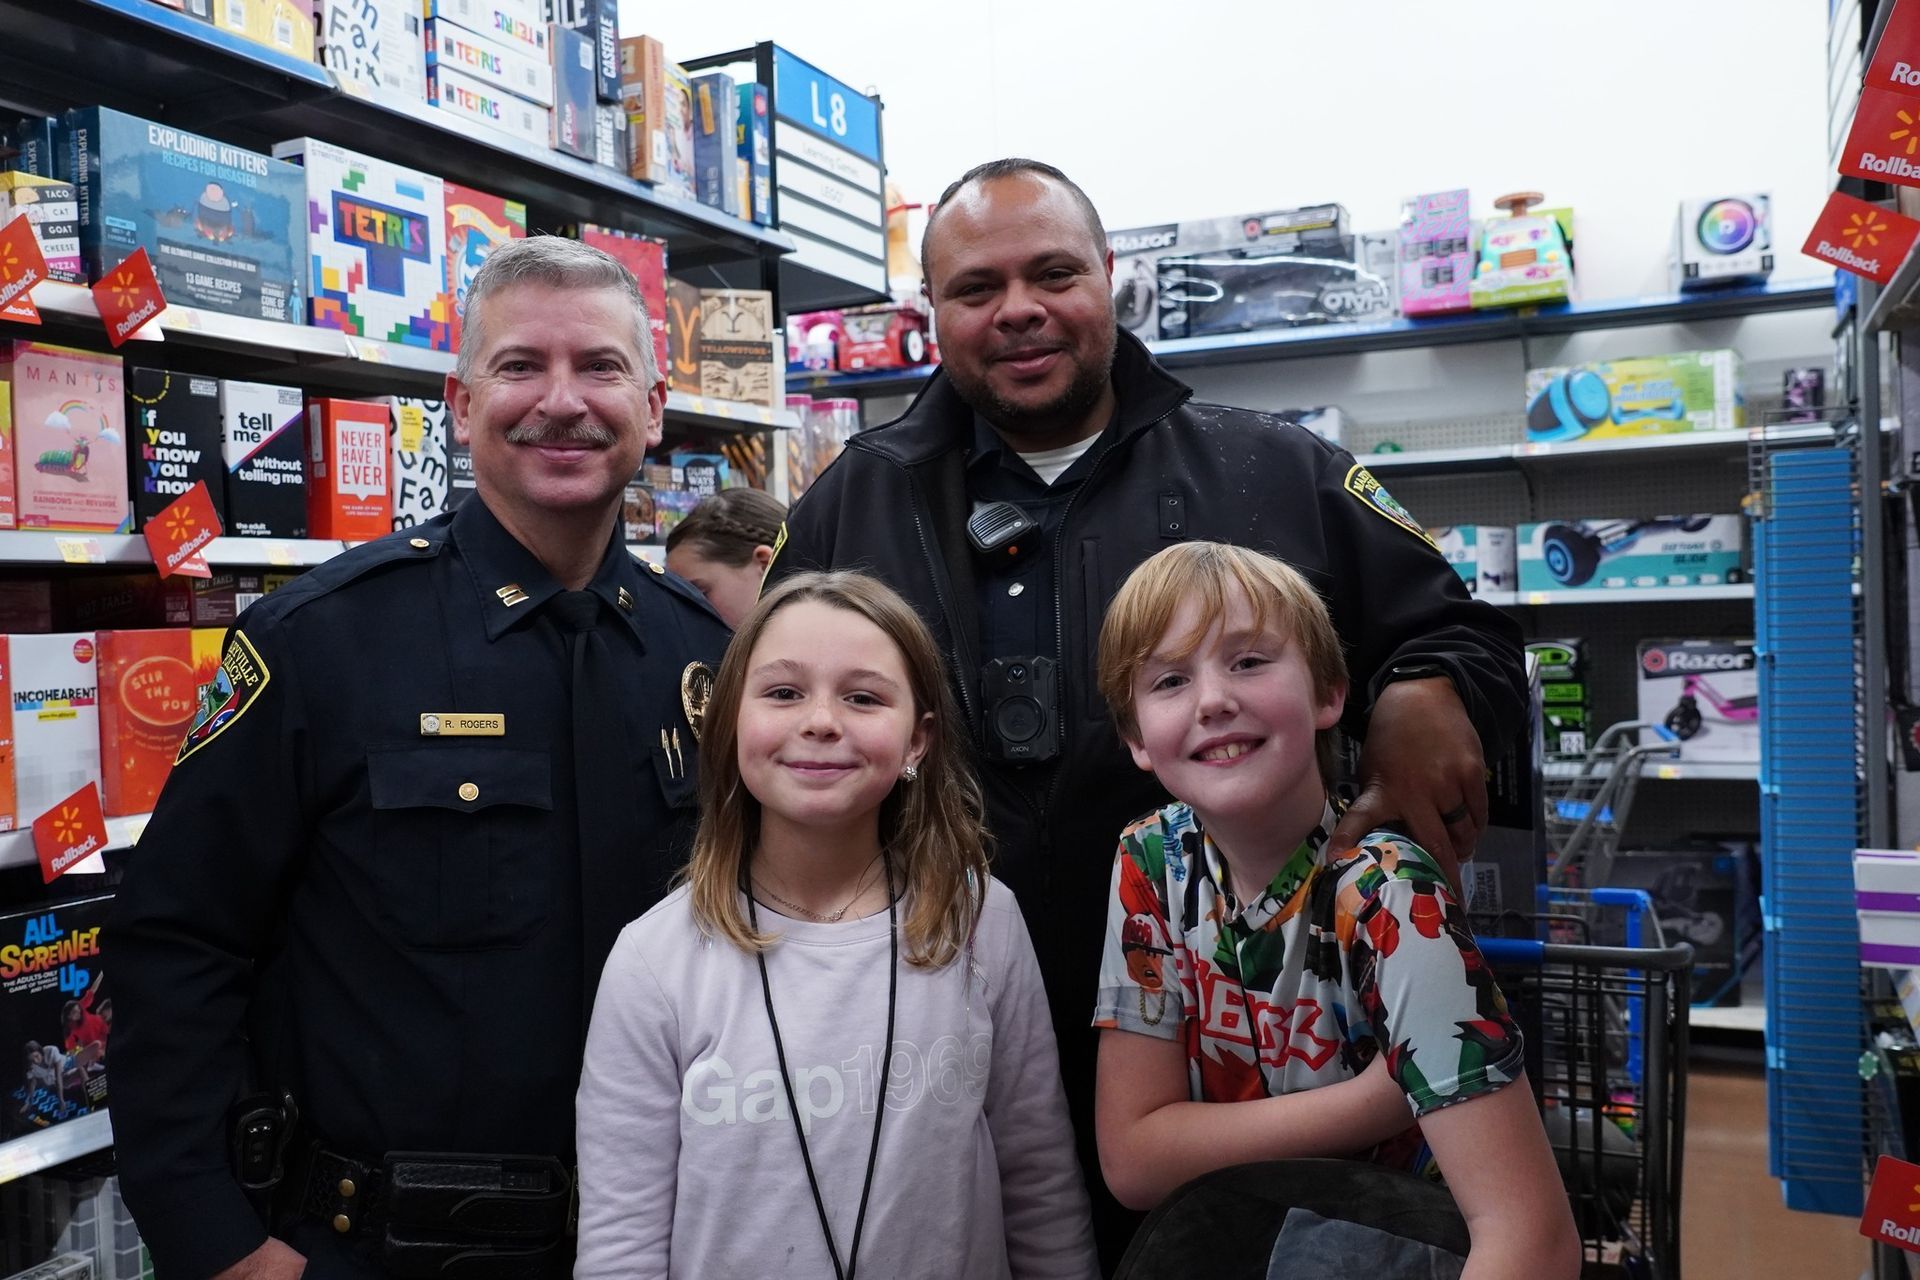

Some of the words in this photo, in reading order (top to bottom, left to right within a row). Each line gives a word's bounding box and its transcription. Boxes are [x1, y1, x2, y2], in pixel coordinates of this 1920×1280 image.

[601, 15, 617, 79] CASEFILE
[456, 41, 502, 75] TETRIS
[456, 87, 500, 119] TETRIS
[811, 80, 847, 136] L8
[77, 128, 89, 183] EXPLODING
[148, 125, 217, 163] EXPLODING
[220, 147, 269, 177] KITTENS
[162, 151, 199, 172] RECIPES
[200, 163, 217, 178] FOR
[218, 167, 258, 189] DISASTER
[45, 190, 70, 198] TACO
[53, 208, 69, 216] CAT
[80, 185, 90, 226] KITTENS
[48, 225, 73, 234] GOAT
[338, 200, 426, 255] TETRIS
[44, 243, 76, 253] CHEESE
[1110, 230, 1176, 251] Razor
[50, 261, 76, 270] PIZZA
[1816, 241, 1881, 275] Rollback
[185, 272, 195, 285] 13
[194, 274, 215, 290] GAME
[214, 278, 242, 294] RECIPES
[261, 295, 276, 308] CONE
[116, 299, 158, 337] Rollback
[261, 305, 286, 320] SHAME
[141, 409, 158, 427] if
[239, 411, 273, 432] tell
[147, 428, 187, 446] you
[233, 429, 262, 443] me
[341, 430, 382, 448] NEVER
[142, 443, 201, 464] know
[341, 449, 371, 465] HAVE
[376, 453, 381, 466] I
[149, 461, 188, 478] you
[252, 456, 303, 471] without
[686, 466, 716, 477] DUMB
[238, 469, 281, 485] telling
[341, 465, 383, 486] EVER
[688, 476, 715, 486] WAYS
[241, 528, 256, 537] party
[166, 526, 213, 568] Rollback
[196, 581, 210, 591] HOT
[213, 575, 233, 587] TAKES
[1667, 651, 1752, 670] Razor
[131, 670, 164, 691] STIR
[13, 686, 97, 704] INCOHEARENT
[146, 686, 171, 699] THE
[161, 700, 190, 711] POT
[445, 720, 455, 729] R.
[460, 720, 499, 729] ROGERS
[51, 834, 98, 873] Rollback
[24, 912, 64, 947] ALL
[3, 980, 16, 988] THE
[16, 970, 58, 985] ADULTS-ONLY
[9, 983, 28, 993] GAME
